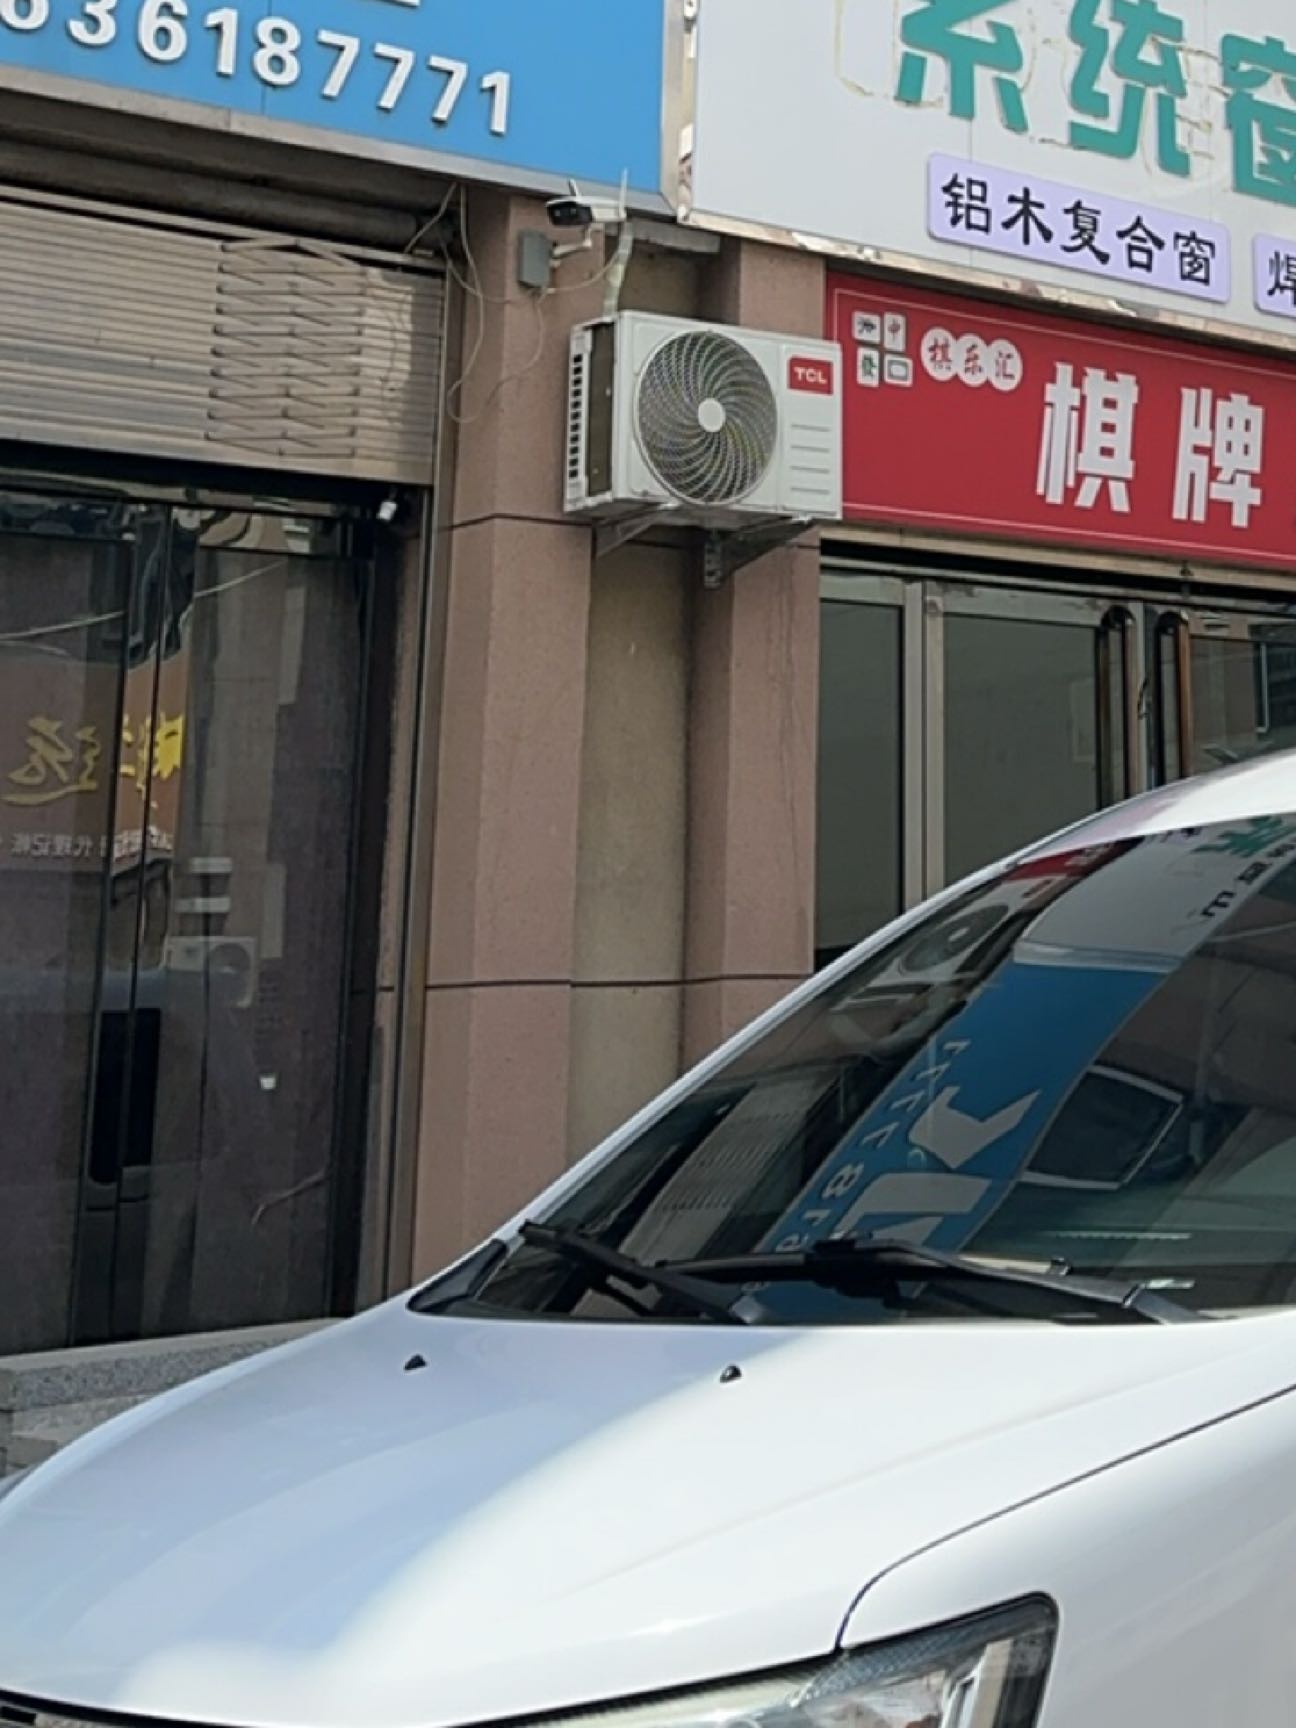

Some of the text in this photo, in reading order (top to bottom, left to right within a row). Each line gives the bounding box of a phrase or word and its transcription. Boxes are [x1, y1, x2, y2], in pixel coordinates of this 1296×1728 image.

[941, 173, 1216, 286] 铝木复合窗
[794, 366, 827, 384] TCL
